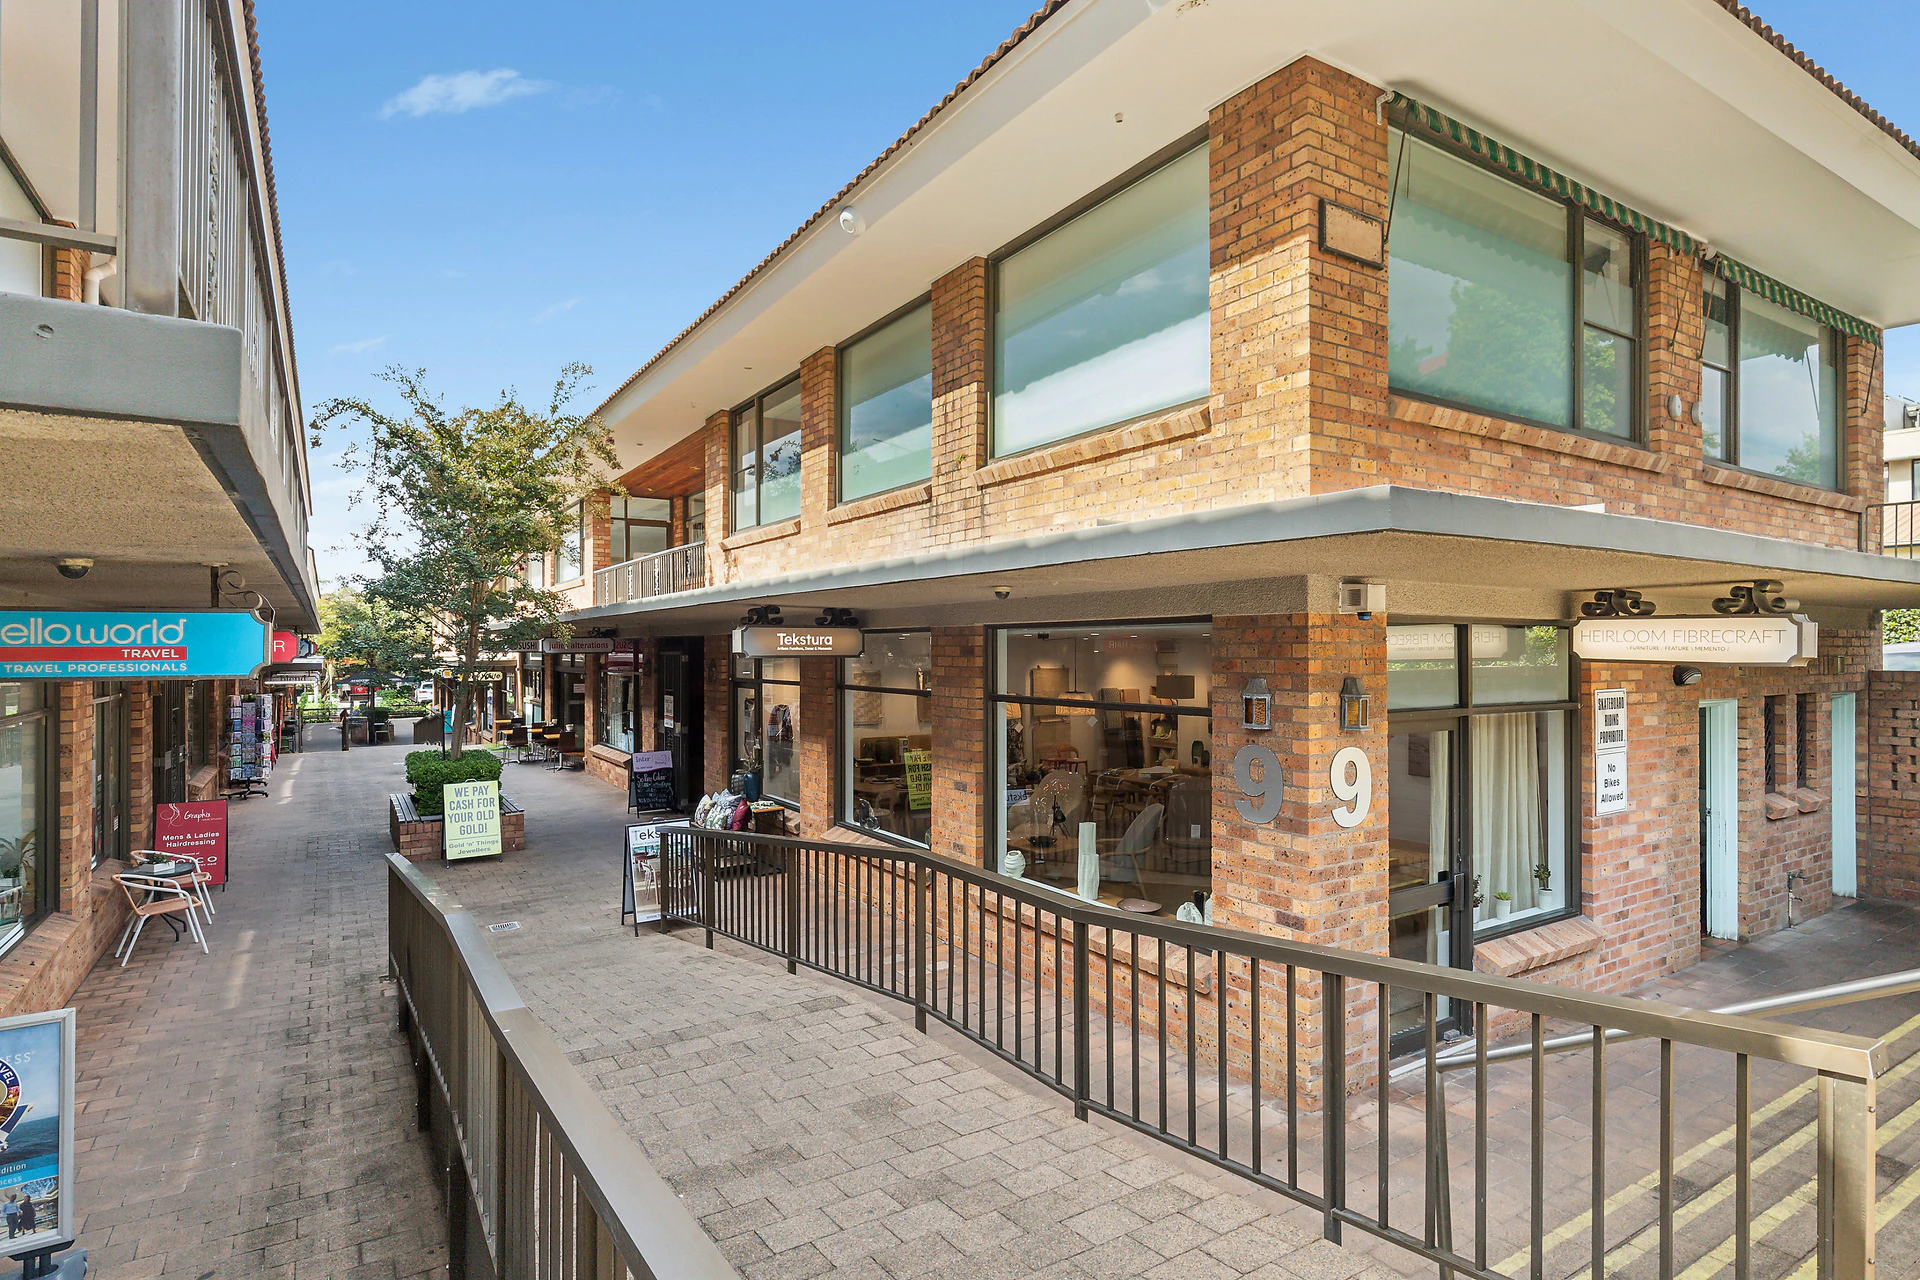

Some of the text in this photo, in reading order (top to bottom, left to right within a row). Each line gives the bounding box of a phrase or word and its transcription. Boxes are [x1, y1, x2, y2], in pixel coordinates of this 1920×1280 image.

[776, 633, 833, 646] Tekstura
[1580, 629, 1787, 644] HEIRLOOM FIBRECRAFT
[570, 641, 609, 649] alterations
[121, 649, 179, 658] TRAVEL
[4, 662, 188, 674] TRAVEL PROFESSIONALS
[1598, 697, 1625, 711] SKATEBOARD
[1604, 713, 1619, 727] RIDING
[1599, 729, 1624, 744] PROHIBITED
[1607, 763, 1617, 773] No
[1233, 744, 1283, 824] 9
[1330, 746, 1372, 828] 9
[1604, 778, 1620, 788] Bikes
[454, 785, 490, 798] WE PAY
[1600, 791, 1624, 804] Allowed
[449, 797, 495, 811] CASH FOR
[448, 810, 495, 823] YOUR OLD
[459, 823, 488, 835] GOLD!
[166, 839, 216, 848] Hairdressing
[448, 841, 465, 849] Gold
[476, 839, 499, 847] Things
[457, 847, 491, 855] Jewellers
